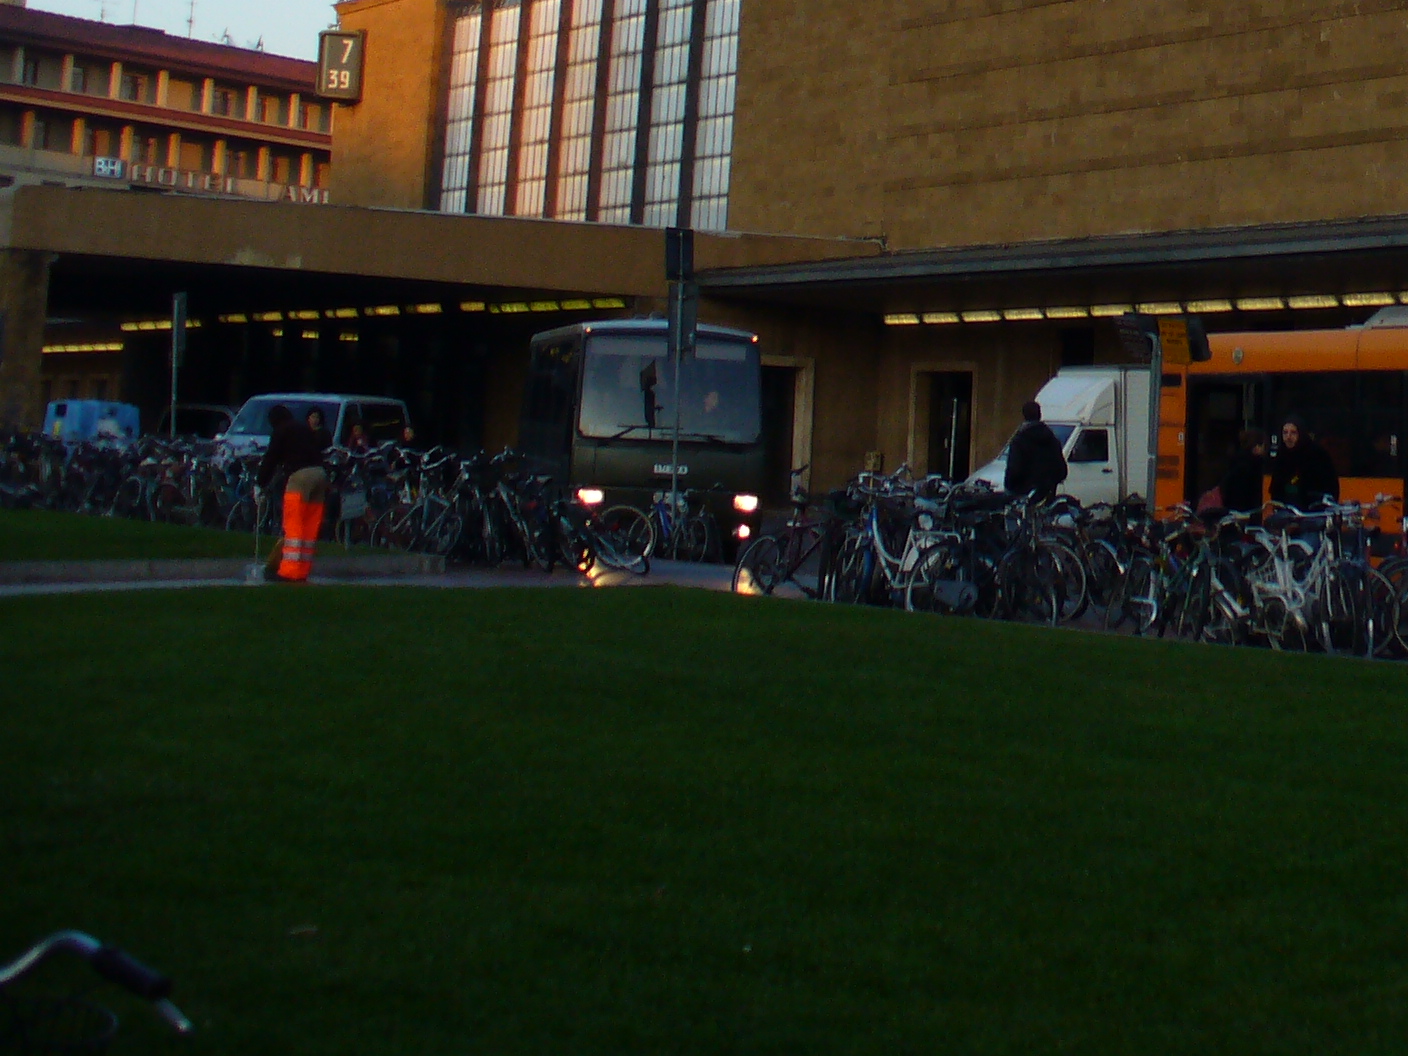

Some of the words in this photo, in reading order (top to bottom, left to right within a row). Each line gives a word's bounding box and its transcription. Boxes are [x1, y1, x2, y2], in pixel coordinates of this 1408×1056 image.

[341, 38, 354, 64] 7
[327, 68, 350, 89] 39
[131, 164, 233, 194] HOTEL
